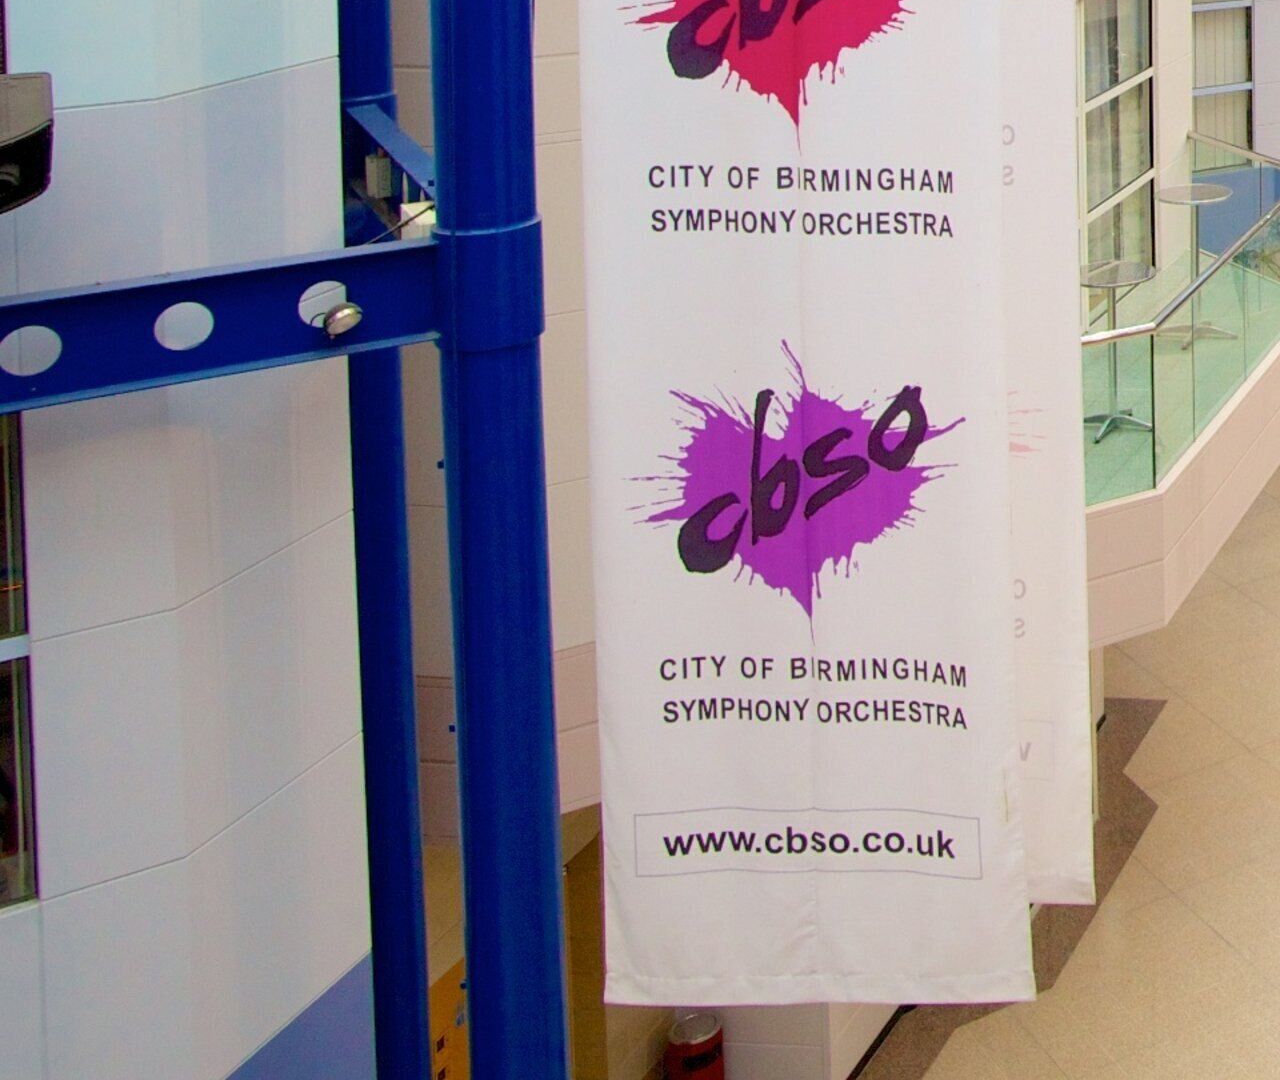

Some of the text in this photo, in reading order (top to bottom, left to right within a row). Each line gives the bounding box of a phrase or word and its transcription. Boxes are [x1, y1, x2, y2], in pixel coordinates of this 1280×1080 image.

[649, 166, 952, 193] CITY OF BIRMINGHAM
[652, 209, 952, 237] SYMPHONY ORCHESTRA
[677, 385, 929, 574] cbso
[660, 656, 965, 687] CITY OF BIRMINGHAM
[664, 698, 966, 729] SYMPHONY ORCHESTRA
[664, 827, 954, 858] www.cbso.co.uk
